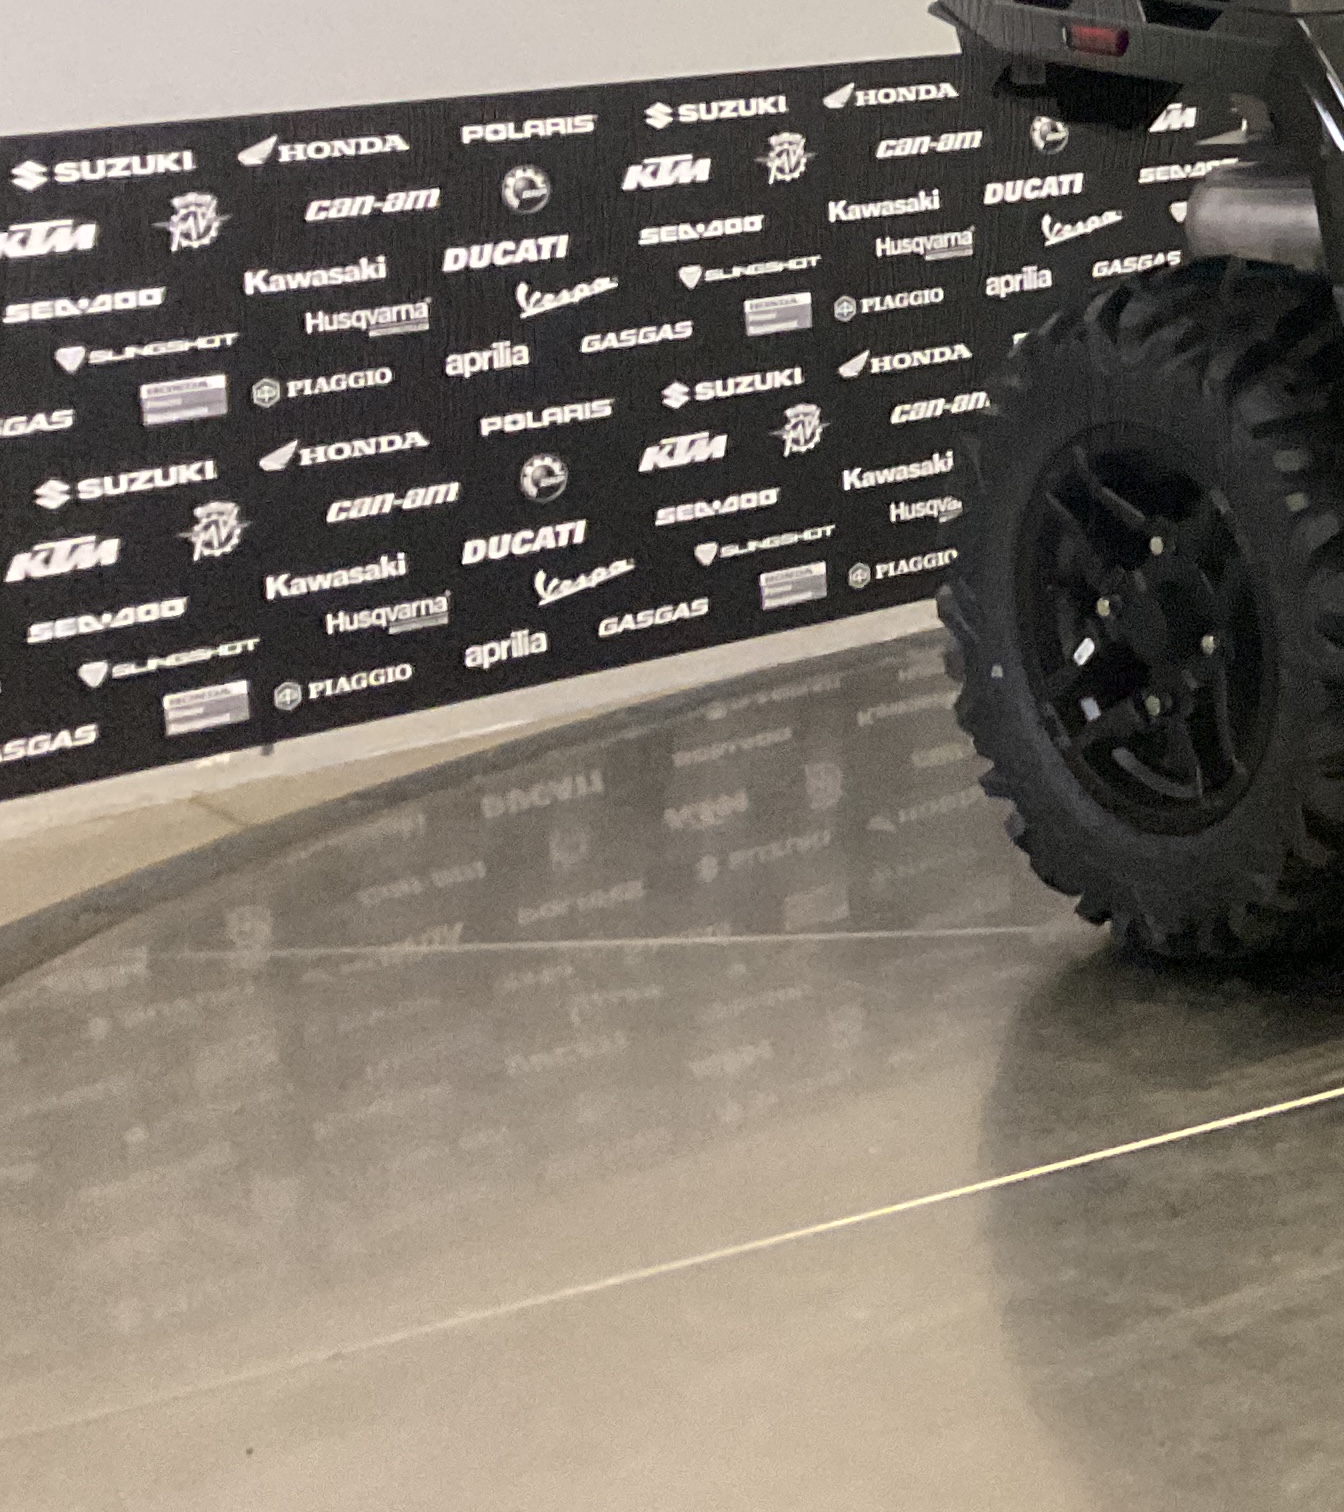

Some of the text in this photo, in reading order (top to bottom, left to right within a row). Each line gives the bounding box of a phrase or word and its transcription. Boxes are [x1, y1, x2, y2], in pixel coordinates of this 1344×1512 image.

[678, 96, 789, 122] SUZUKI
[855, 83, 959, 106] HONDA
[460, 114, 598, 144] POLARIS
[876, 131, 982, 159] can-am
[278, 134, 409, 162] HONDA
[54, 150, 196, 182] SUZUKI
[621, 153, 711, 191] KTM
[305, 187, 440, 222] can-am
[828, 188, 940, 223] Kawasaki
[984, 173, 1083, 204] DUCATI
[442, 233, 569, 273] DUCATI
[876, 226, 974, 260] Husqvarna
[244, 254, 388, 296] Kawasaki
[986, 266, 1052, 298] aprilia
[515, 277, 618, 319] Vespa
[860, 288, 944, 313] PIAGGIO
[305, 298, 430, 337] Husqvarna
[579, 320, 694, 353] GASGAS
[445, 340, 530, 379] aprilia
[870, 344, 972, 373] HONDA
[287, 367, 392, 397] PIAGGIO
[695, 367, 803, 400] SUZUKI
[480, 398, 615, 437] POLARIS
[299, 432, 429, 465] HONDA
[638, 430, 728, 472] KTM
[77, 461, 217, 499] SUZUKI
[842, 449, 954, 491] Kawasaki
[326, 481, 461, 523] can-am
[3, 534, 121, 583] KTM
[461, 519, 587, 565] DUCATI
[266, 552, 408, 601] Kawasaki
[325, 590, 451, 635] Husqvarna
[598, 597, 709, 637] GASGAS
[465, 628, 548, 669] aprilia
[309, 664, 412, 699] PIAGGIO
